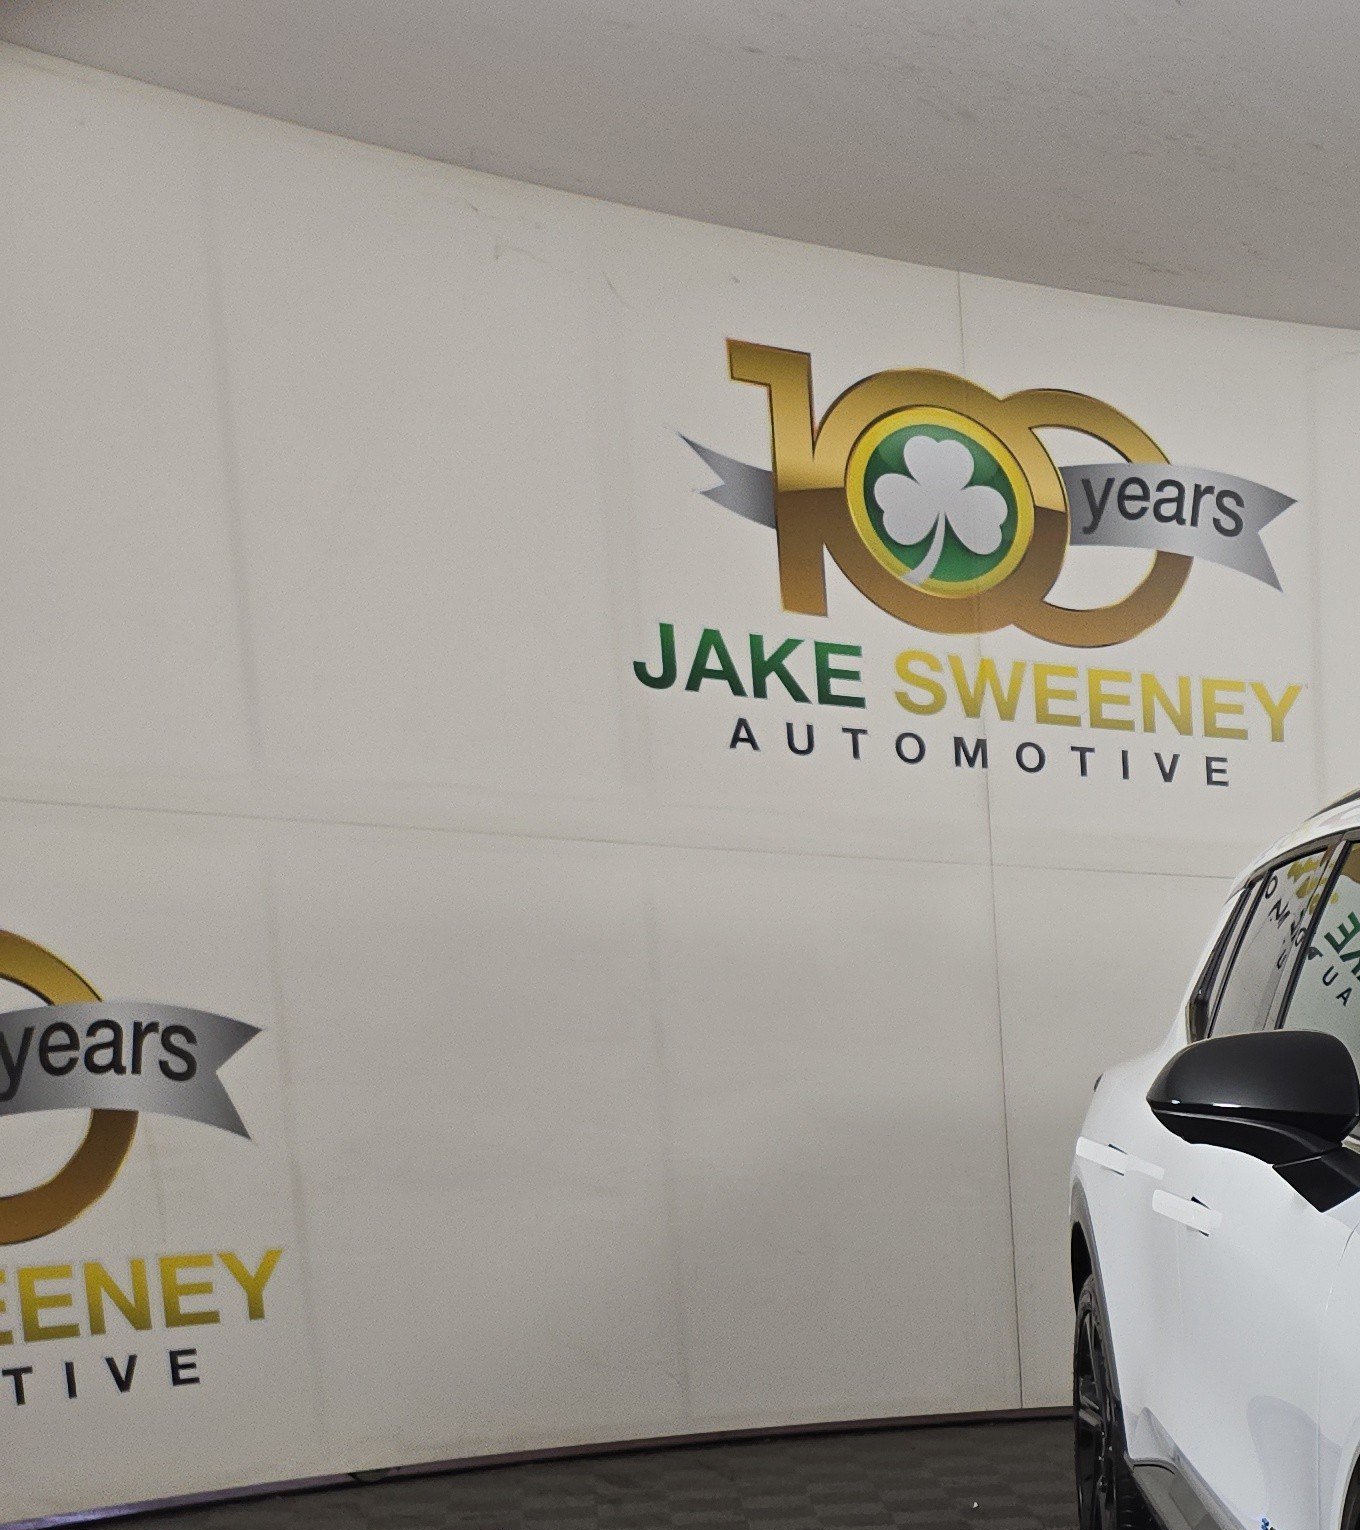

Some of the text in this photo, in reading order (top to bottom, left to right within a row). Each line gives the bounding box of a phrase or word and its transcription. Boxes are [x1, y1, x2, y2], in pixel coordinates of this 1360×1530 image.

[726, 339, 1245, 648] 100 years
[632, 622, 1302, 743] JAKE SWEENEY
[729, 717, 1230, 787] AUTOMOTIVE
[0, 1017, 198, 1097] years
[0, 1248, 283, 1346] ENEY
